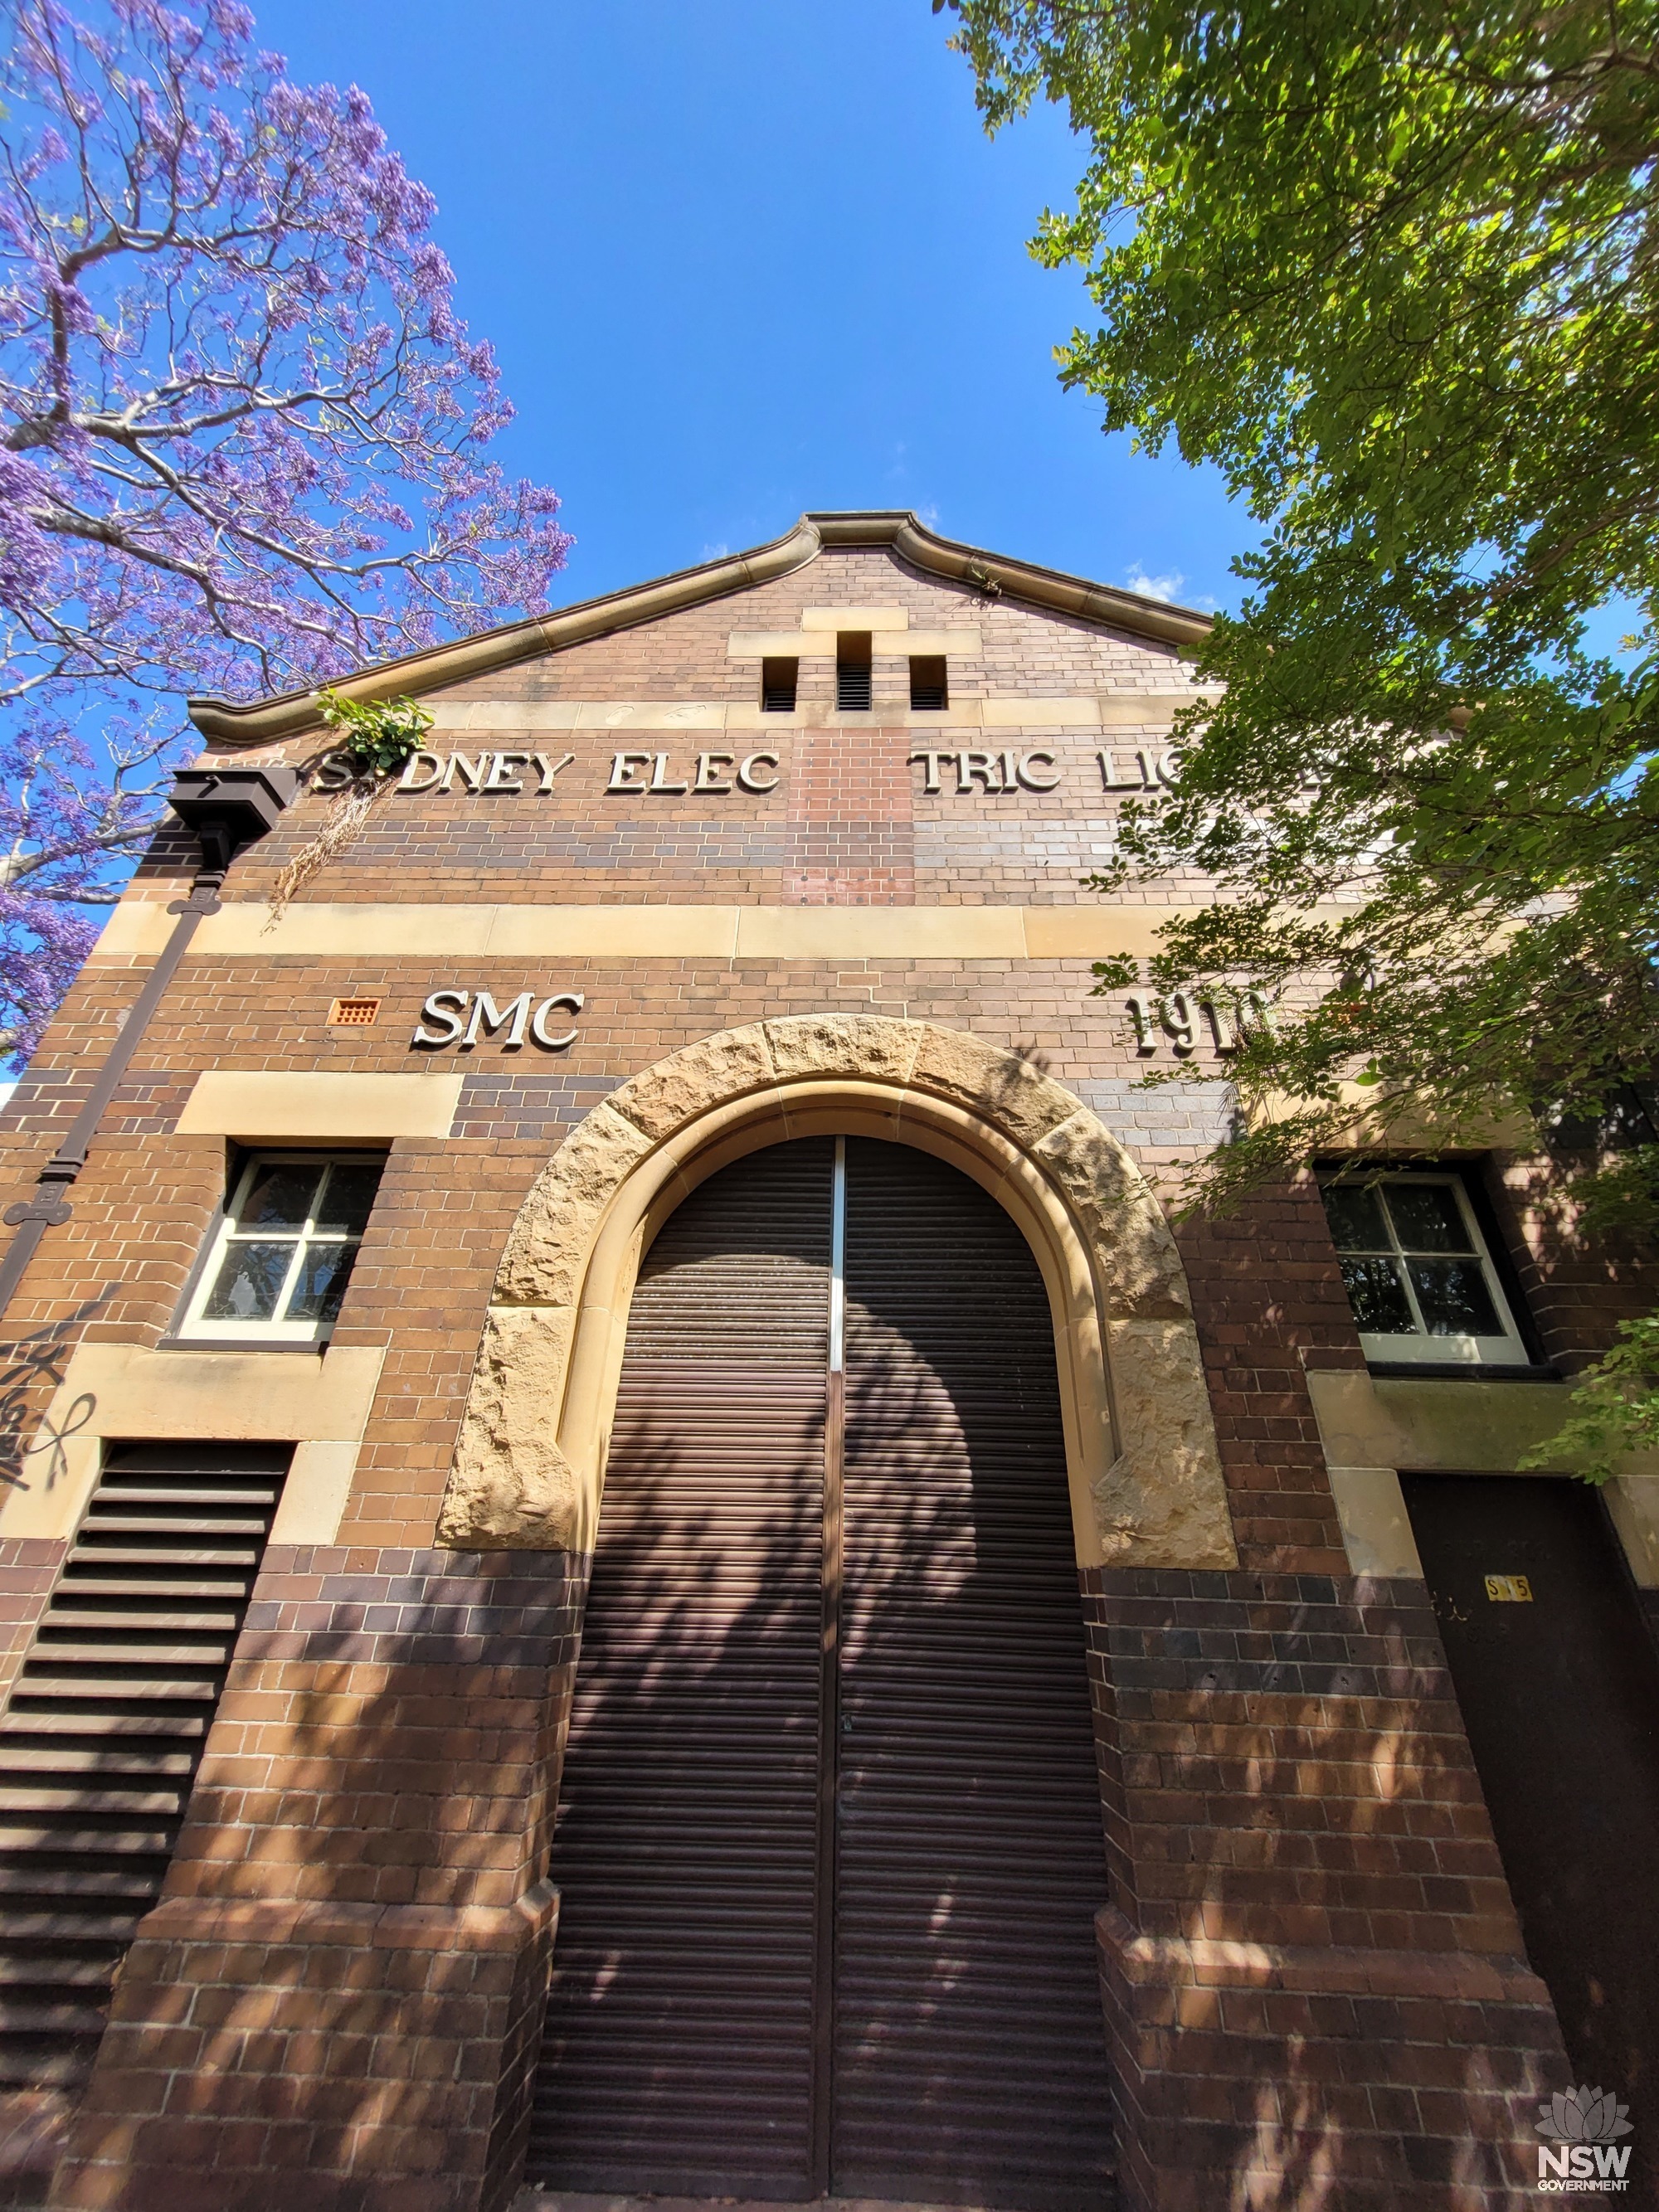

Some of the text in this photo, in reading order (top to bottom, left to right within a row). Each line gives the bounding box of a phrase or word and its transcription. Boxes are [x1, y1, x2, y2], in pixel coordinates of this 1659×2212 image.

[314, 750, 577, 791] SDNEY
[606, 751, 781, 792] ELEC
[910, 750, 1063, 789] TRIC
[413, 990, 585, 1048] SMC
